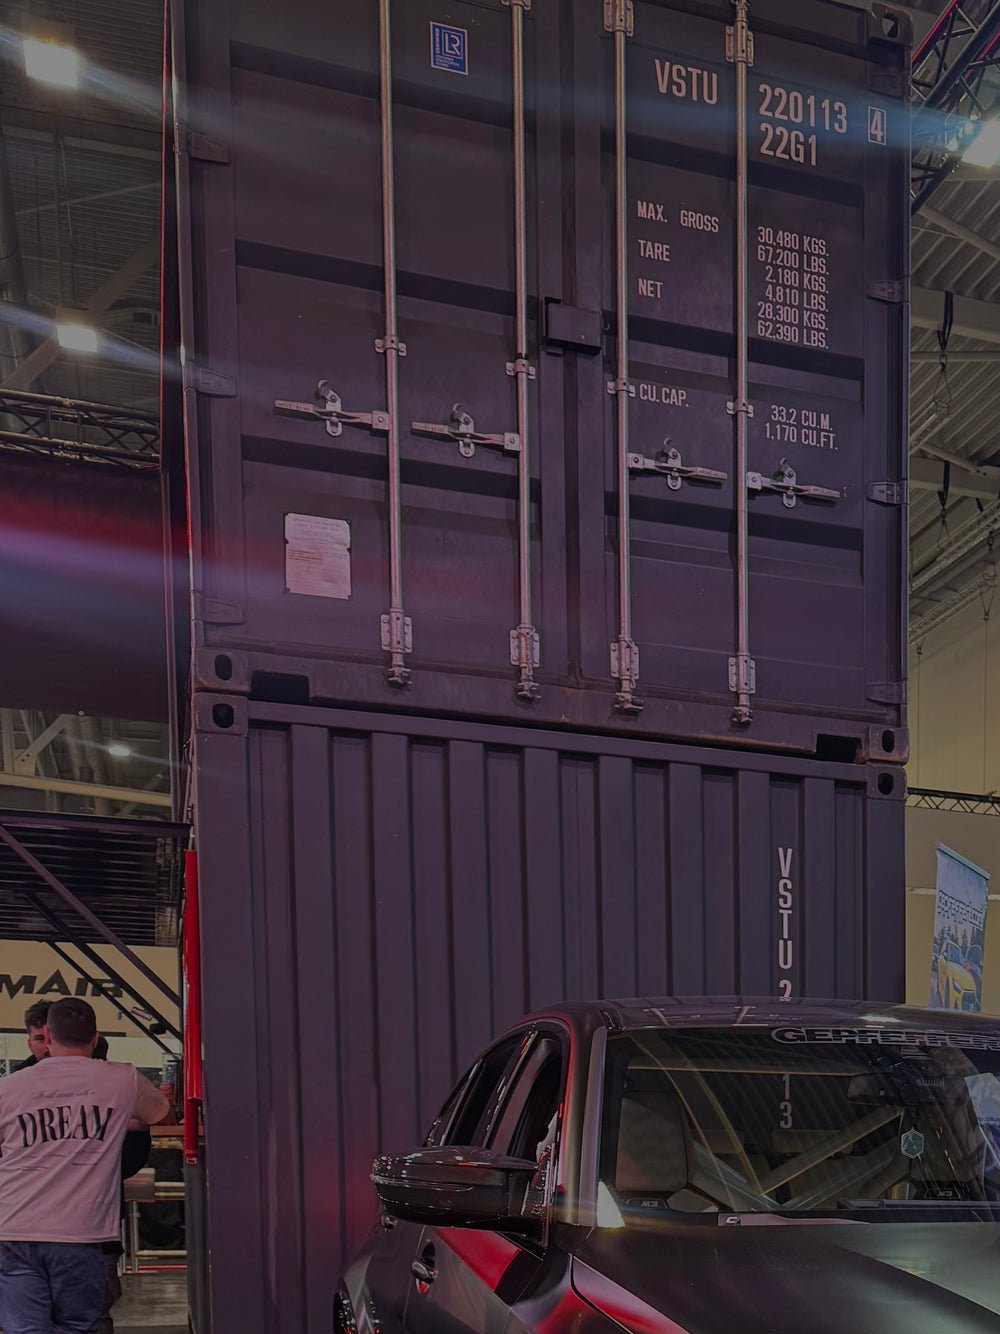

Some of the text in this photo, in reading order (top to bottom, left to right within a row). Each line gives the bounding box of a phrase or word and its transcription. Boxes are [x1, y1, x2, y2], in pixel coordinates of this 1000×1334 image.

[445, 33, 461, 56] LR
[654, 58, 883, 142] VSTU 220113 4
[759, 123, 818, 166] 22G1
[637, 200, 720, 233] MAX. GROSS
[638, 240, 671, 262] TARE
[757, 226, 829, 256] 30.480 KGS.
[757, 245, 829, 275] 67.200 LBS.
[638, 278, 663, 298] NET
[765, 265, 829, 293] 2.180 KGS.
[765, 284, 829, 312] 4.810 LBS.
[757, 301, 829, 331] 28.300 KGS.
[757, 320, 829, 349] 62.390 LBS.
[771, 405, 796, 425] 33.2
[764, 422, 797, 443] 1.170
[778, 847, 793, 969] VSTU
